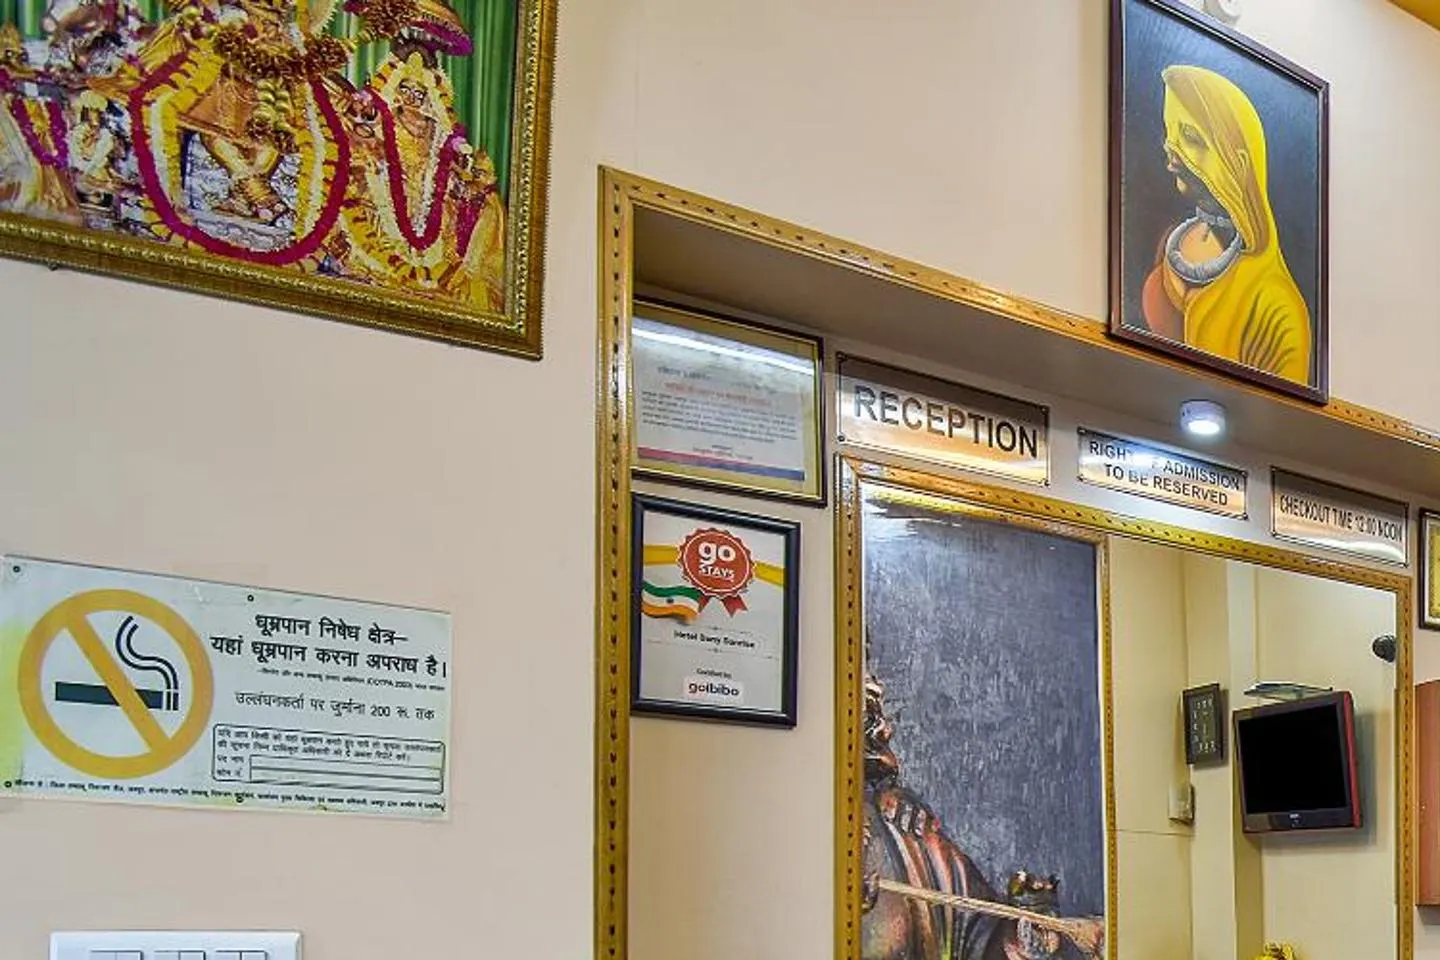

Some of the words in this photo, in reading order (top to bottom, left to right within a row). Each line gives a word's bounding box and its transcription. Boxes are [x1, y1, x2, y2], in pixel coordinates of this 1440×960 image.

[853, 385, 1038, 458] RECEPTION
[1089, 441, 1133, 462] RIGH
[1163, 460, 1240, 491] ADMISSION
[1105, 463, 1124, 481] TO
[1128, 469, 1149, 487] BE
[1153, 475, 1228, 506] RESERVED
[1280, 494, 1330, 525] CHECKOUT
[698, 541, 736, 565] go
[699, 564, 736, 582] STAYS
[319, 617, 361, 642] निषेध
[315, 648, 359, 668] करना
[365, 653, 419, 674] अपराध
[370, 705, 391, 717] 200
